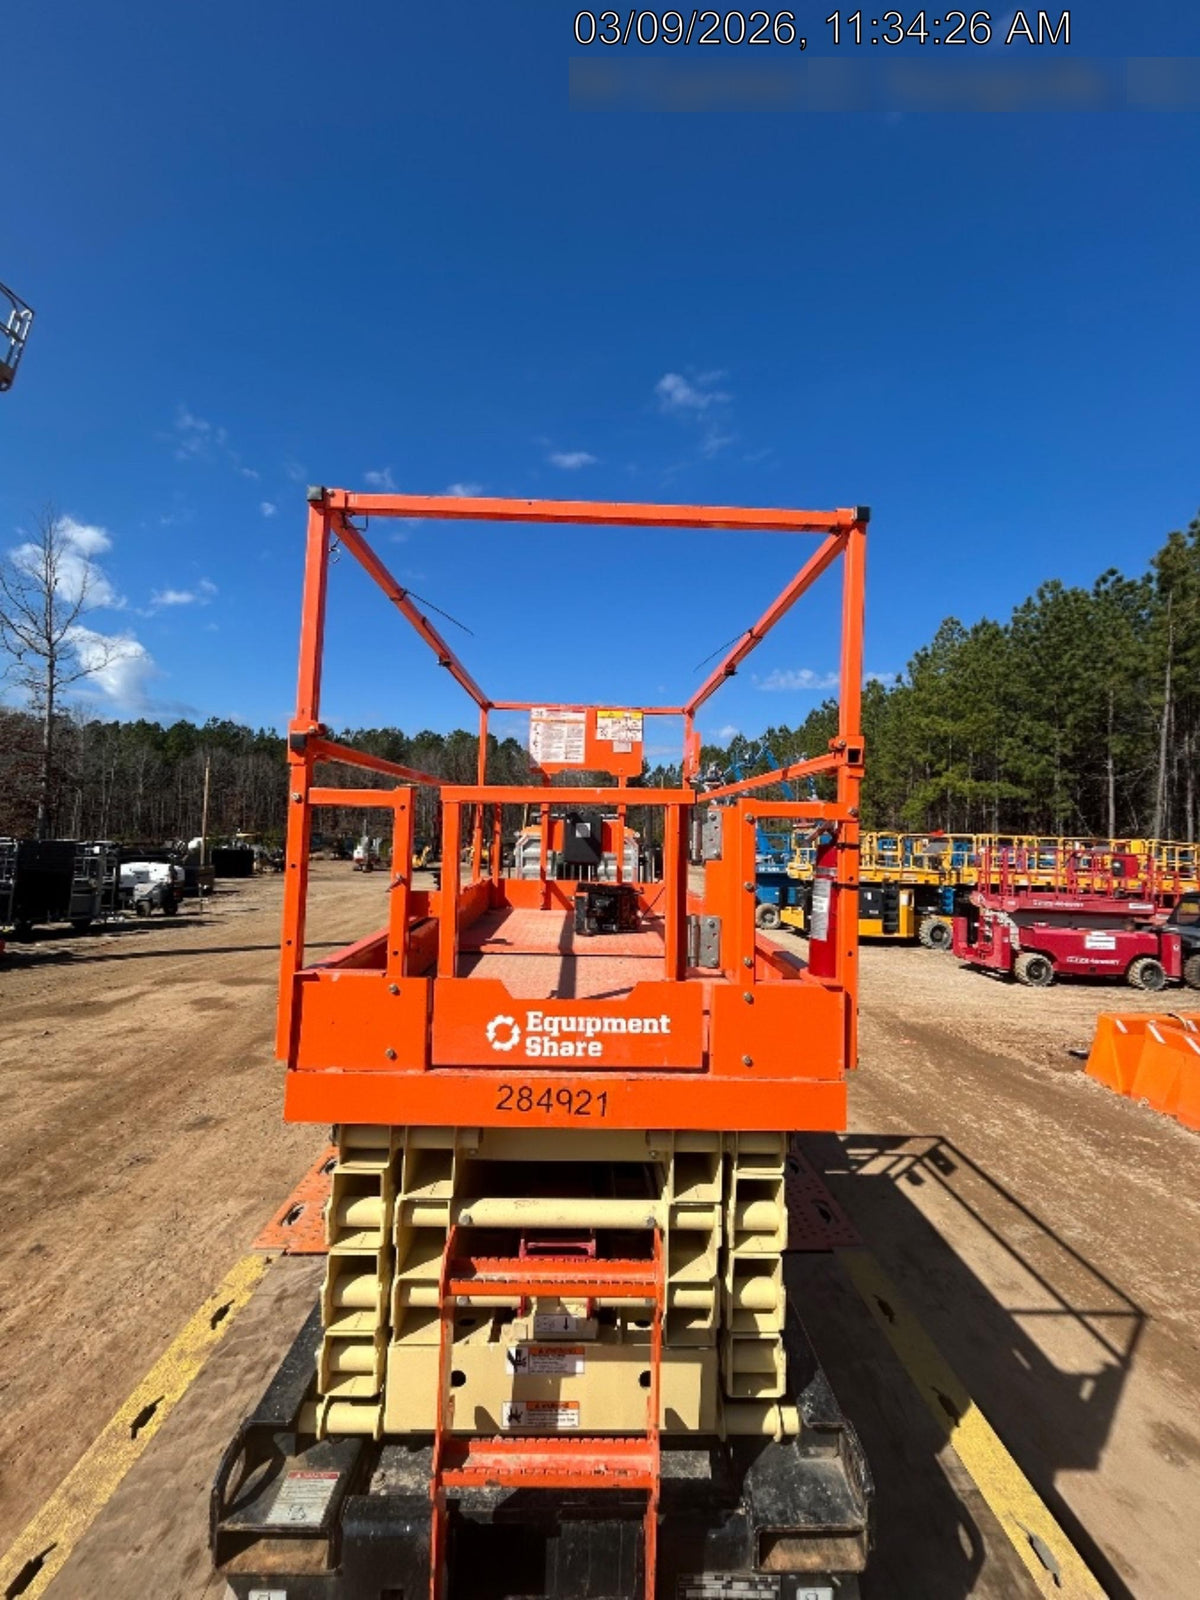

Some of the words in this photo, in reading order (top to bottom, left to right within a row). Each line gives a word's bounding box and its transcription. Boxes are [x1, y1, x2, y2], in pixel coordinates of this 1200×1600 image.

[525, 1010, 671, 1037] Equipment
[525, 1035, 602, 1057] Share
[496, 1085, 607, 1117] 284921
